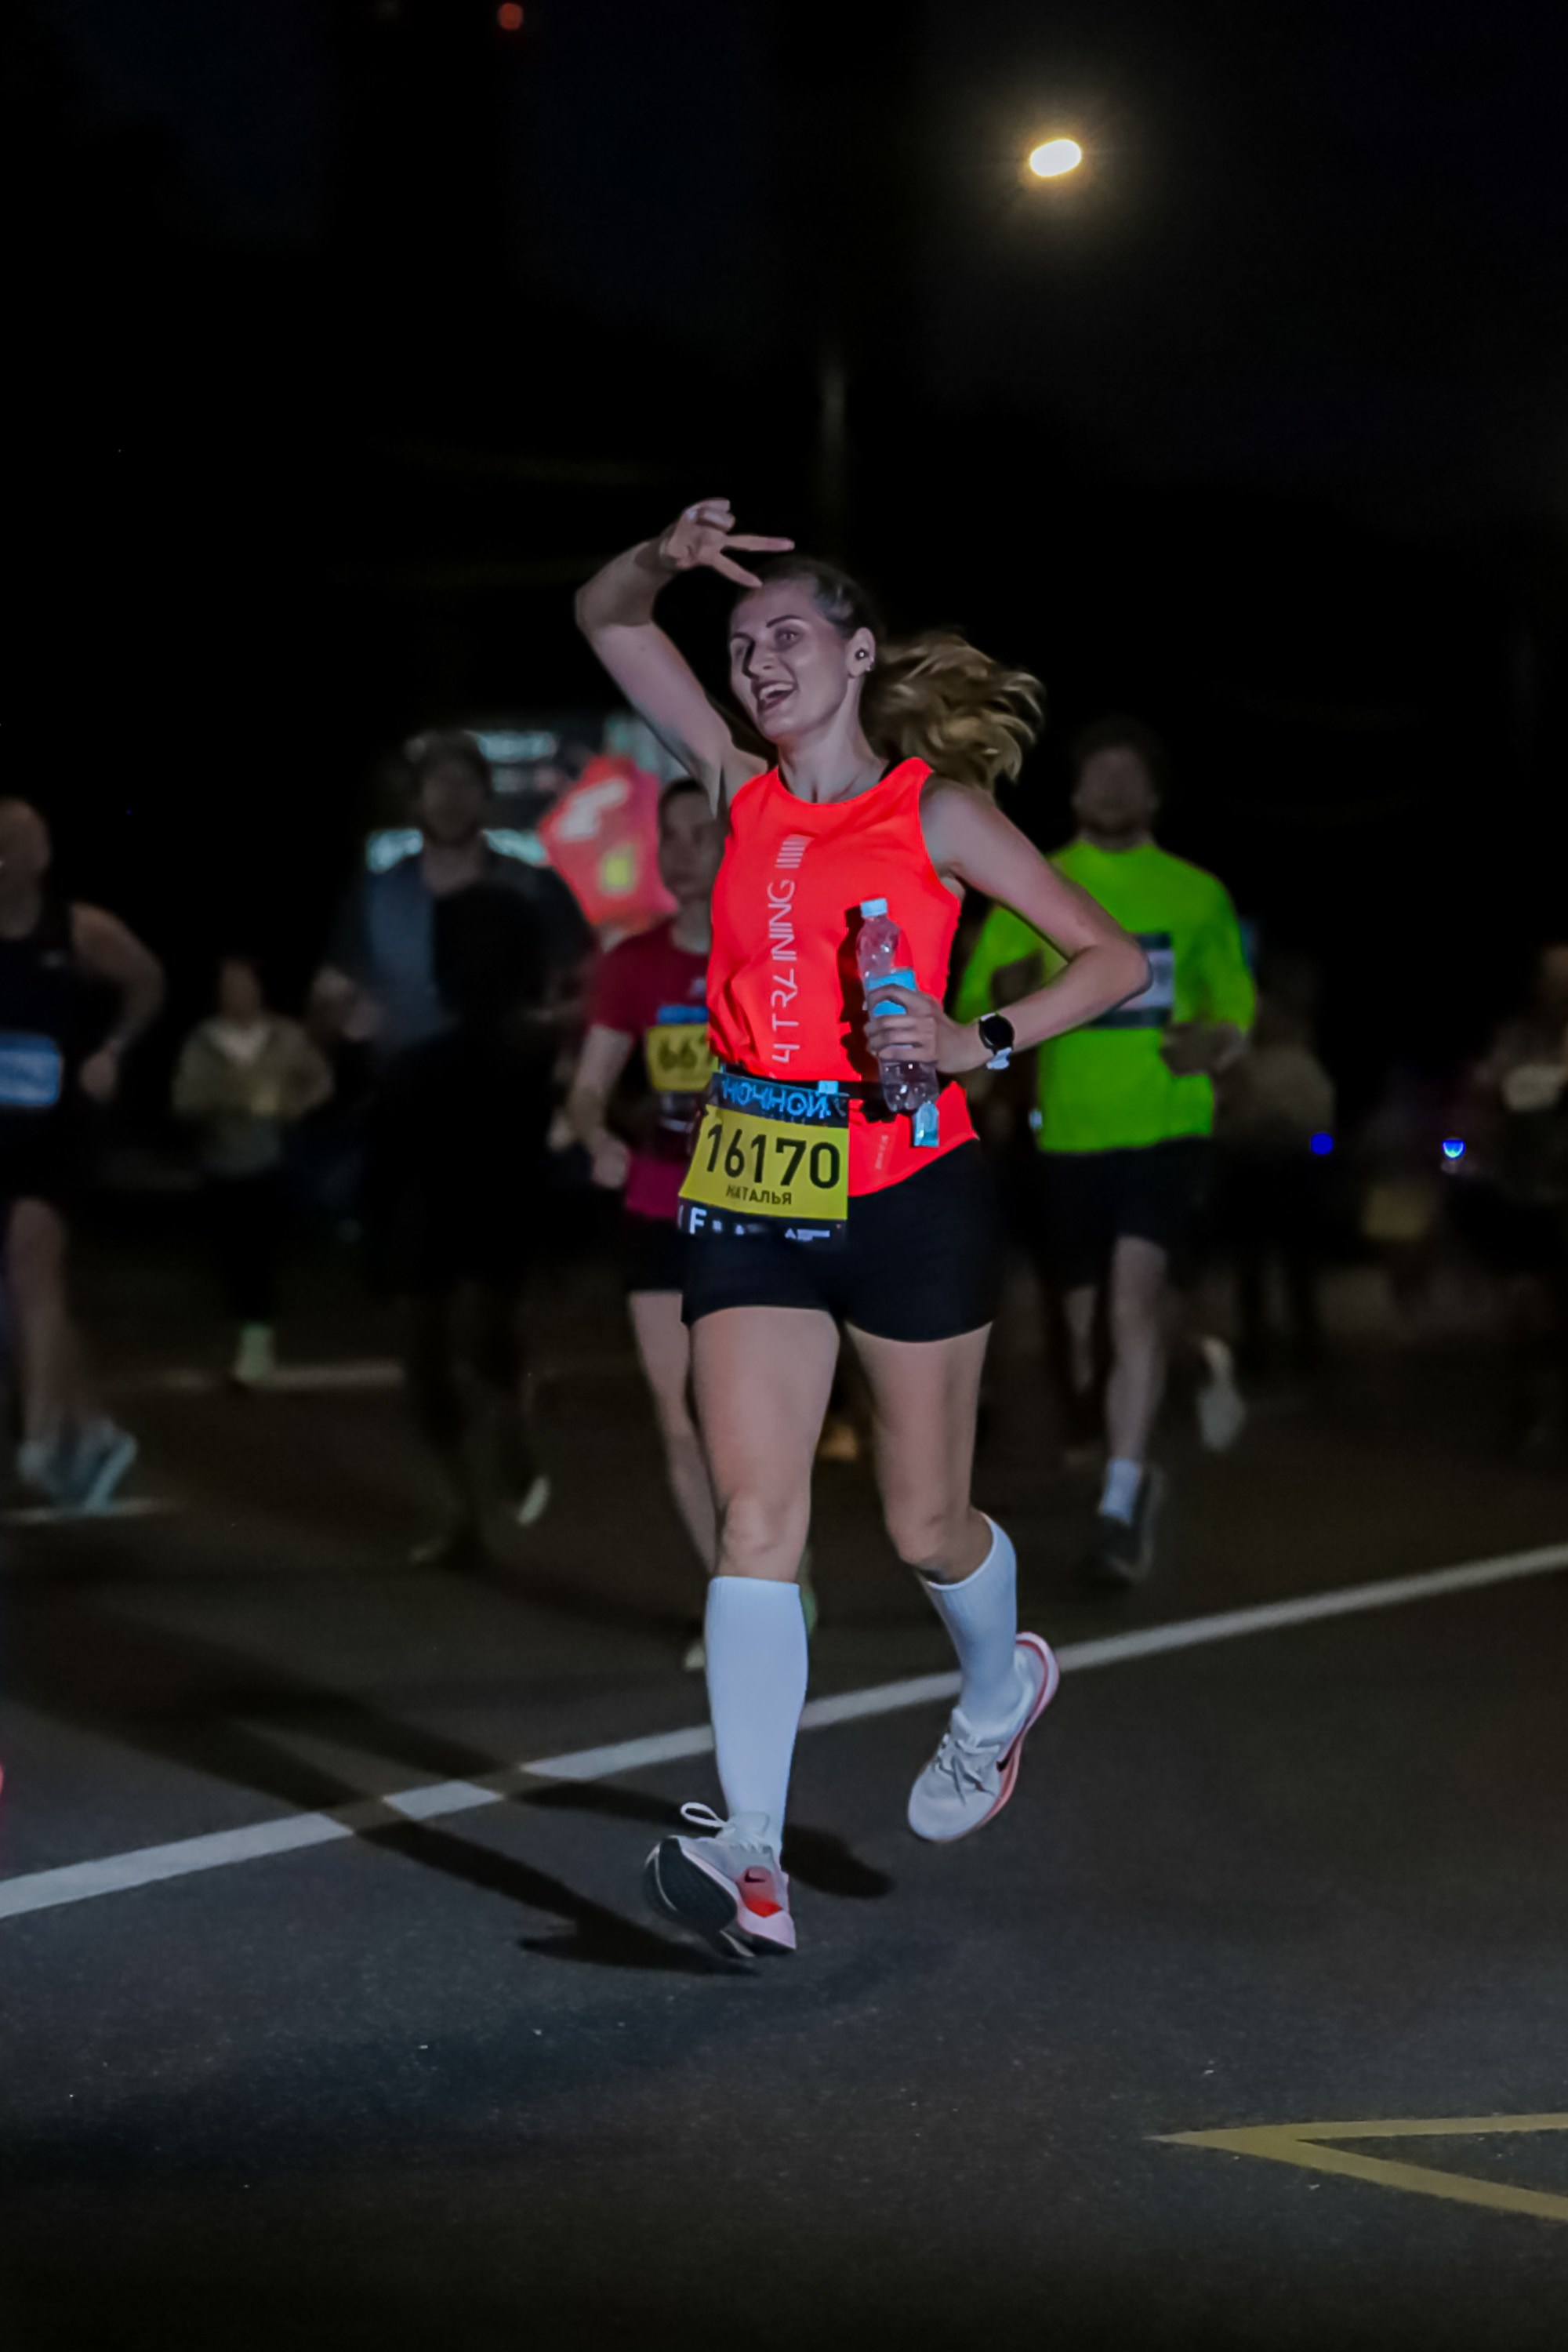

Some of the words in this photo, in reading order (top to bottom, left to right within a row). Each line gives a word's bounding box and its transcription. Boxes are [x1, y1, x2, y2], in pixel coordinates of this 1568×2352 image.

[767, 879, 800, 1033] TRAINING
[721, 1076, 831, 1120] НОЧНОЙ
[706, 1123, 840, 1189] 16170
[725, 1184, 793, 1205] НАТАЛЬЯ
